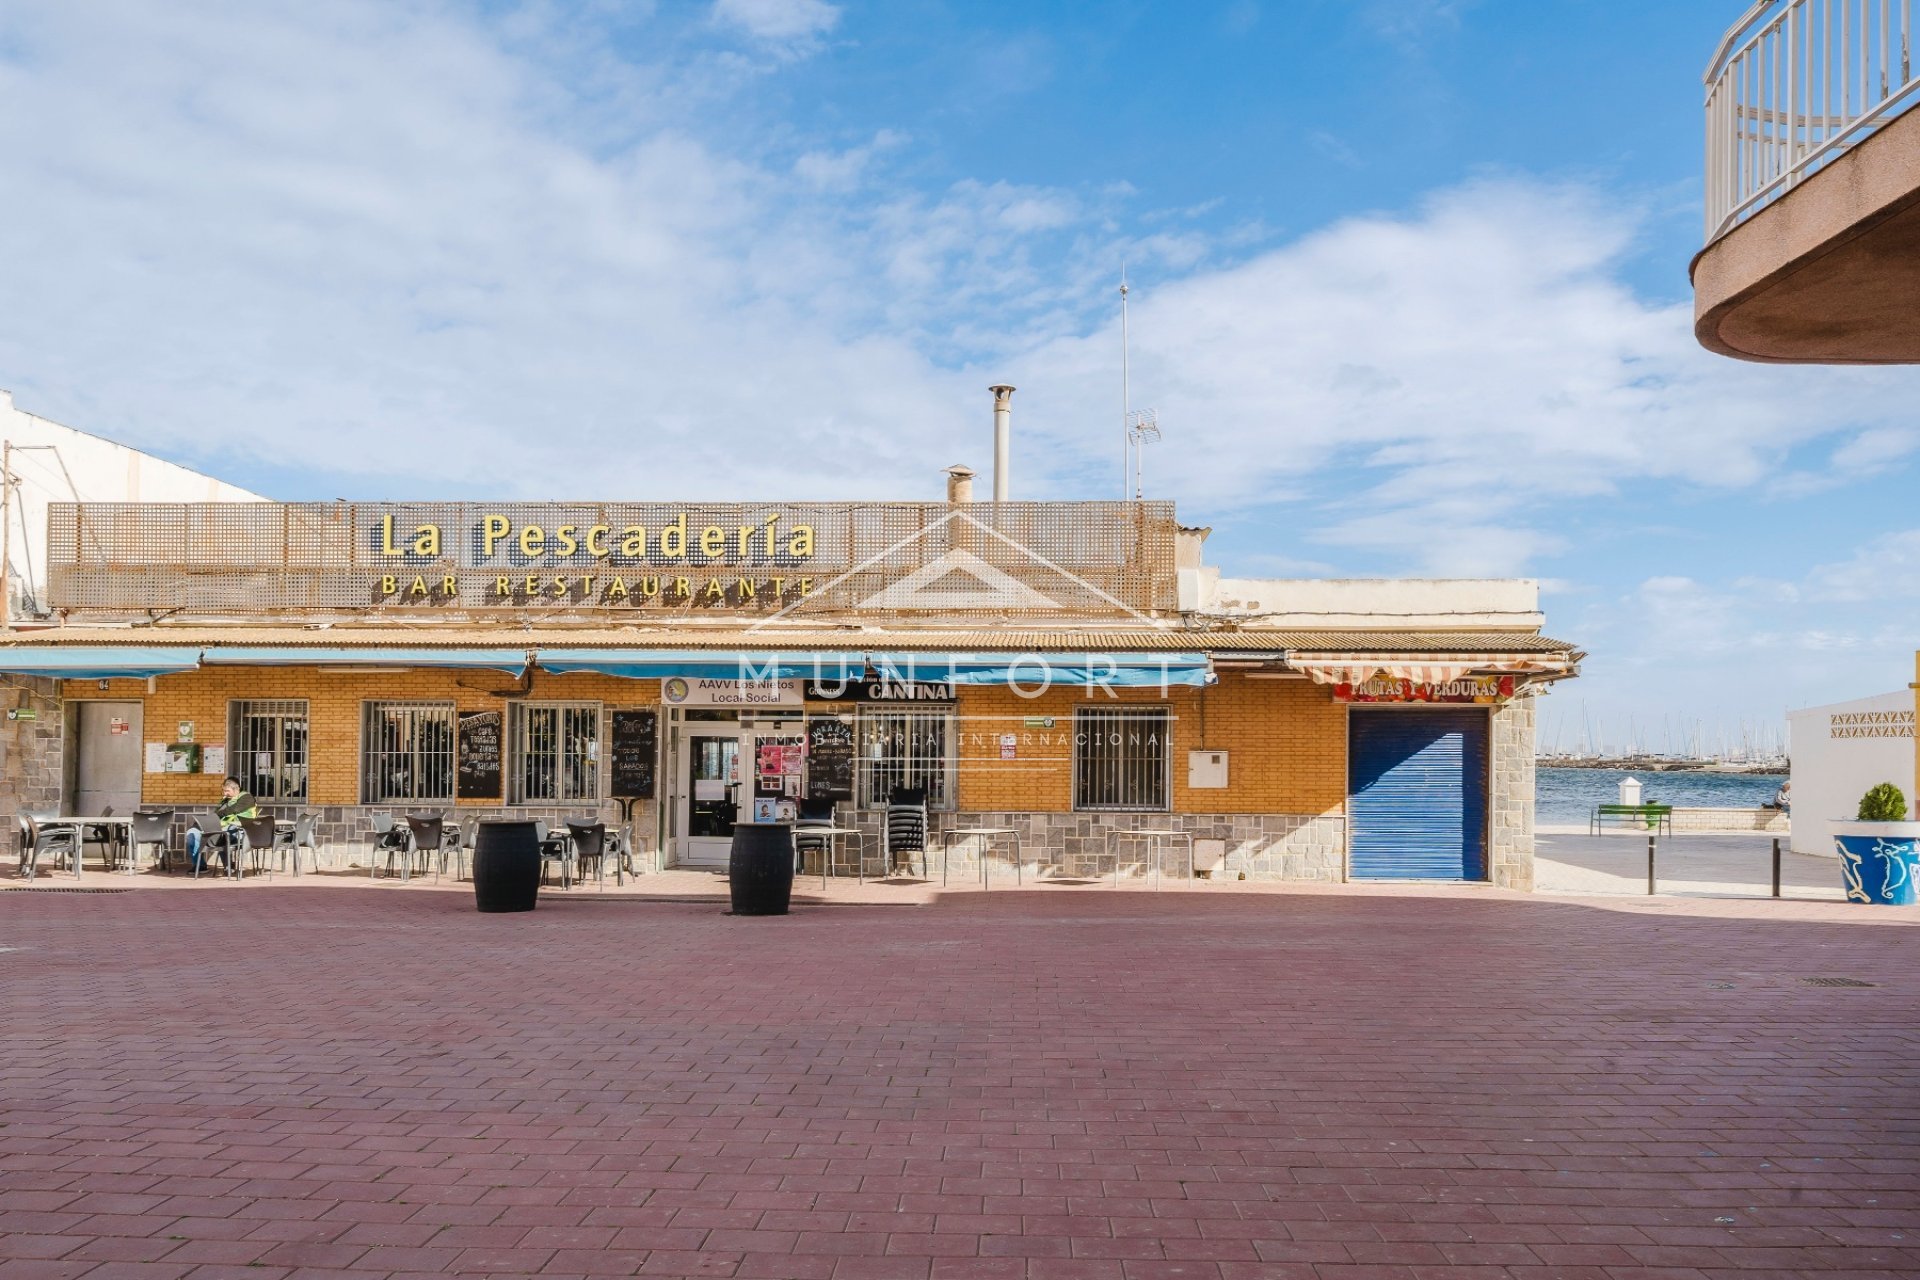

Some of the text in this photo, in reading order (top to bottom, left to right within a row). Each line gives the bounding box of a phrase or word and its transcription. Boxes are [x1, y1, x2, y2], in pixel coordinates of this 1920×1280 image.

[383, 512, 815, 557] La Pescadería
[382, 575, 815, 597] BAR RESTAURANTE
[735, 680, 754, 689] Los
[868, 683, 948, 699] CANTINA
[1409, 681, 1418, 695] Y
[1424, 681, 1497, 696] VERDURAS
[711, 693, 781, 702] Local Social
